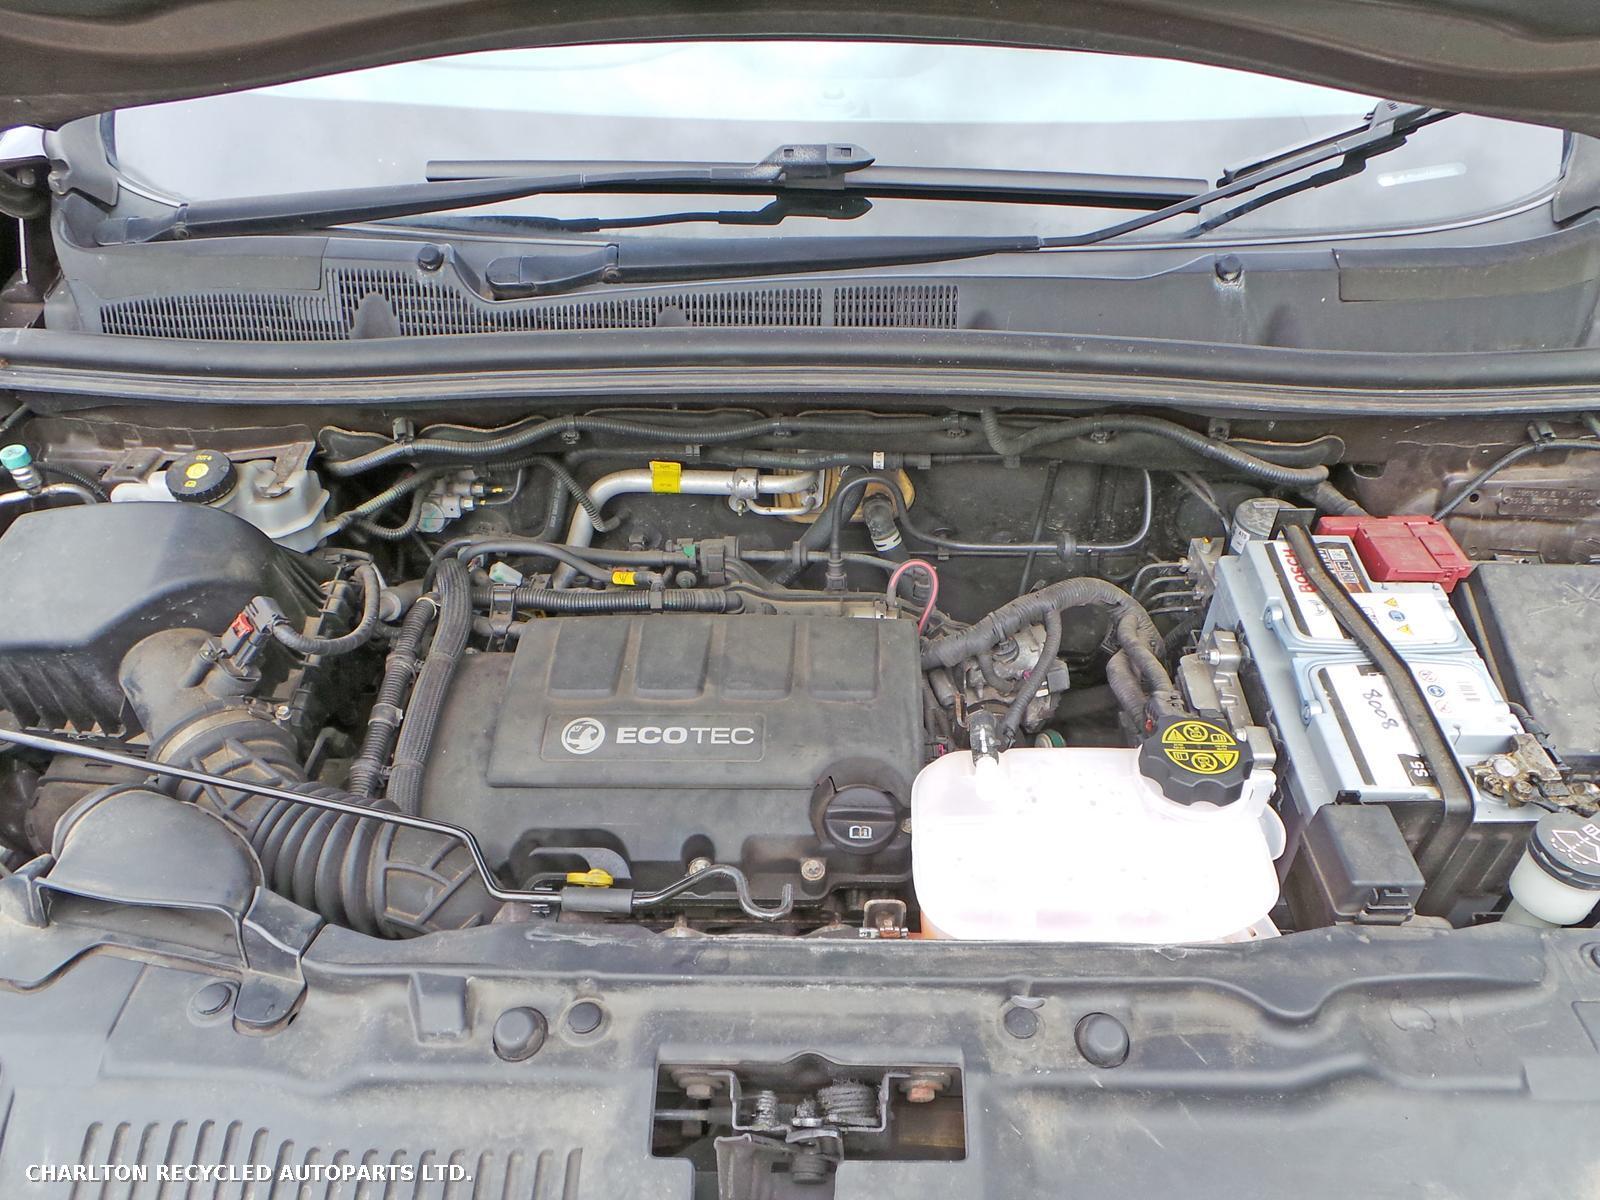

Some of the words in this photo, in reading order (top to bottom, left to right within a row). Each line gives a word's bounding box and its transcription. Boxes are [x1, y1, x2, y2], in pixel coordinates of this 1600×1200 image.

[1282, 548, 1318, 593] BOSCH
[1362, 688, 1399, 729] 8008
[616, 727, 755, 745] ECOTEC
[1409, 759, 1429, 778] S5
